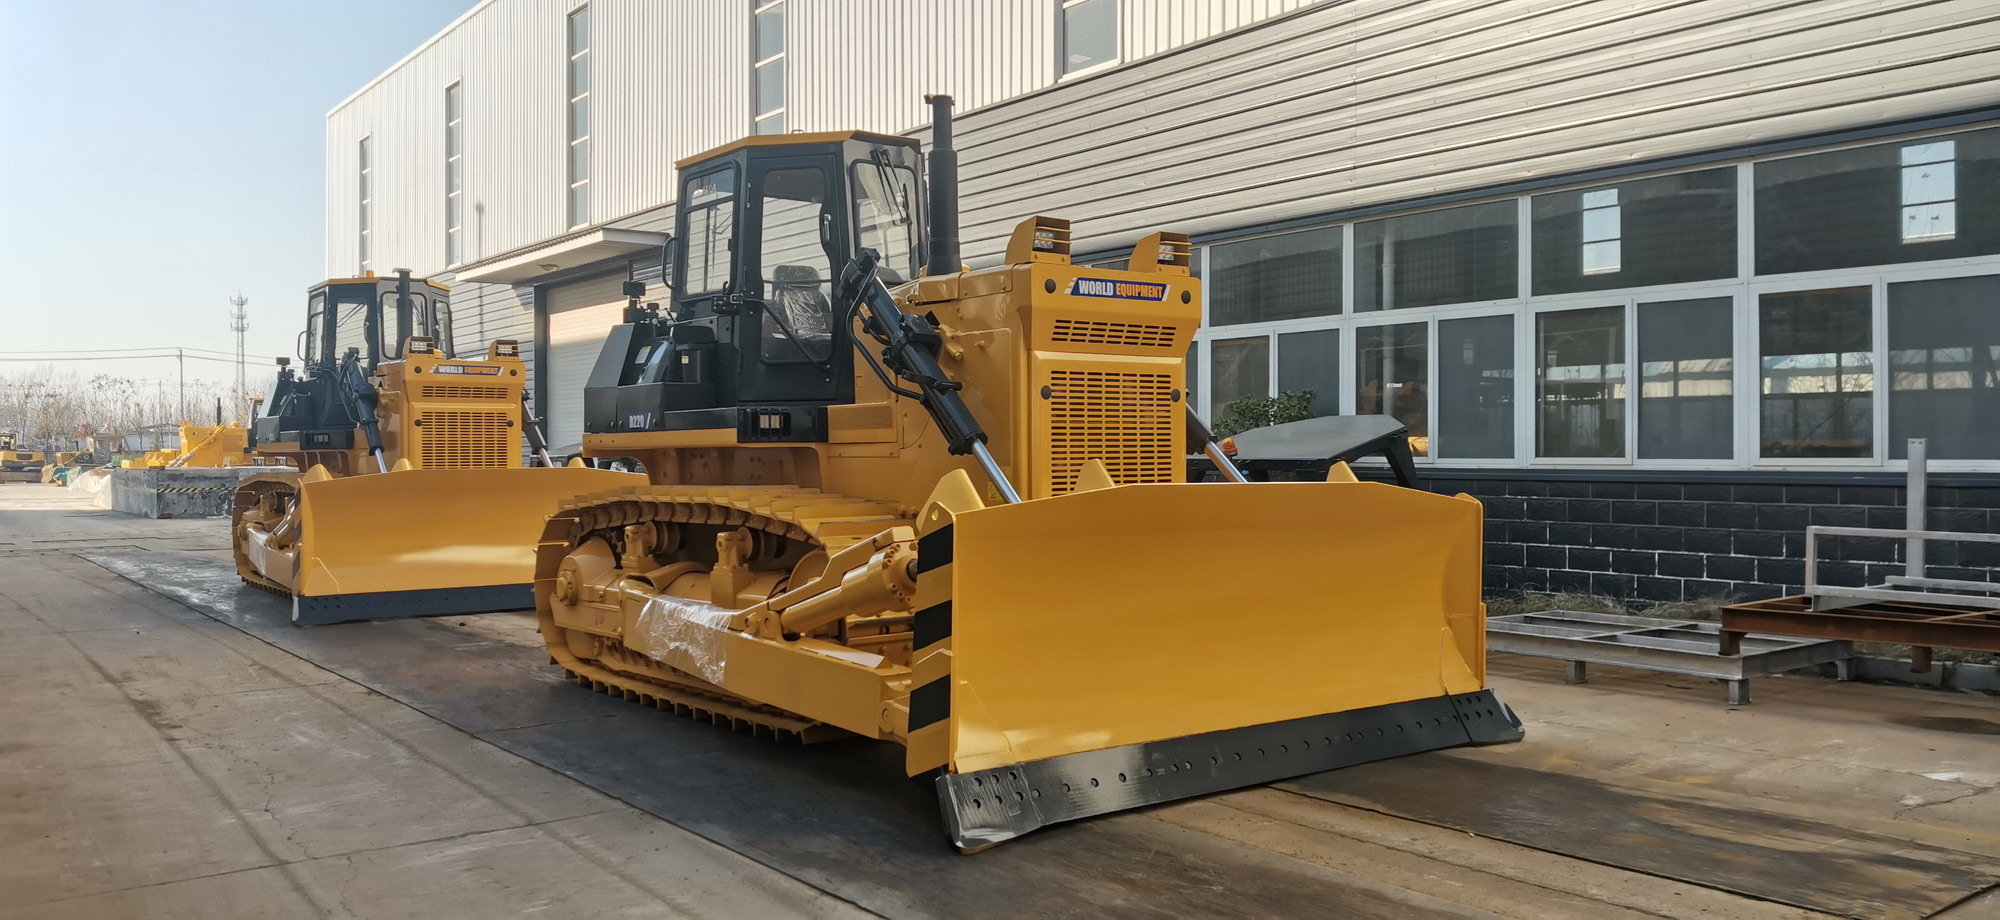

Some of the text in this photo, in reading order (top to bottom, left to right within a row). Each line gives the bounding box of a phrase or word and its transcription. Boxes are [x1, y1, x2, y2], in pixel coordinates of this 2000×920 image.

[1078, 280, 1163, 298] WORLD EQUIPMENT
[438, 365, 464, 374] WORLD
